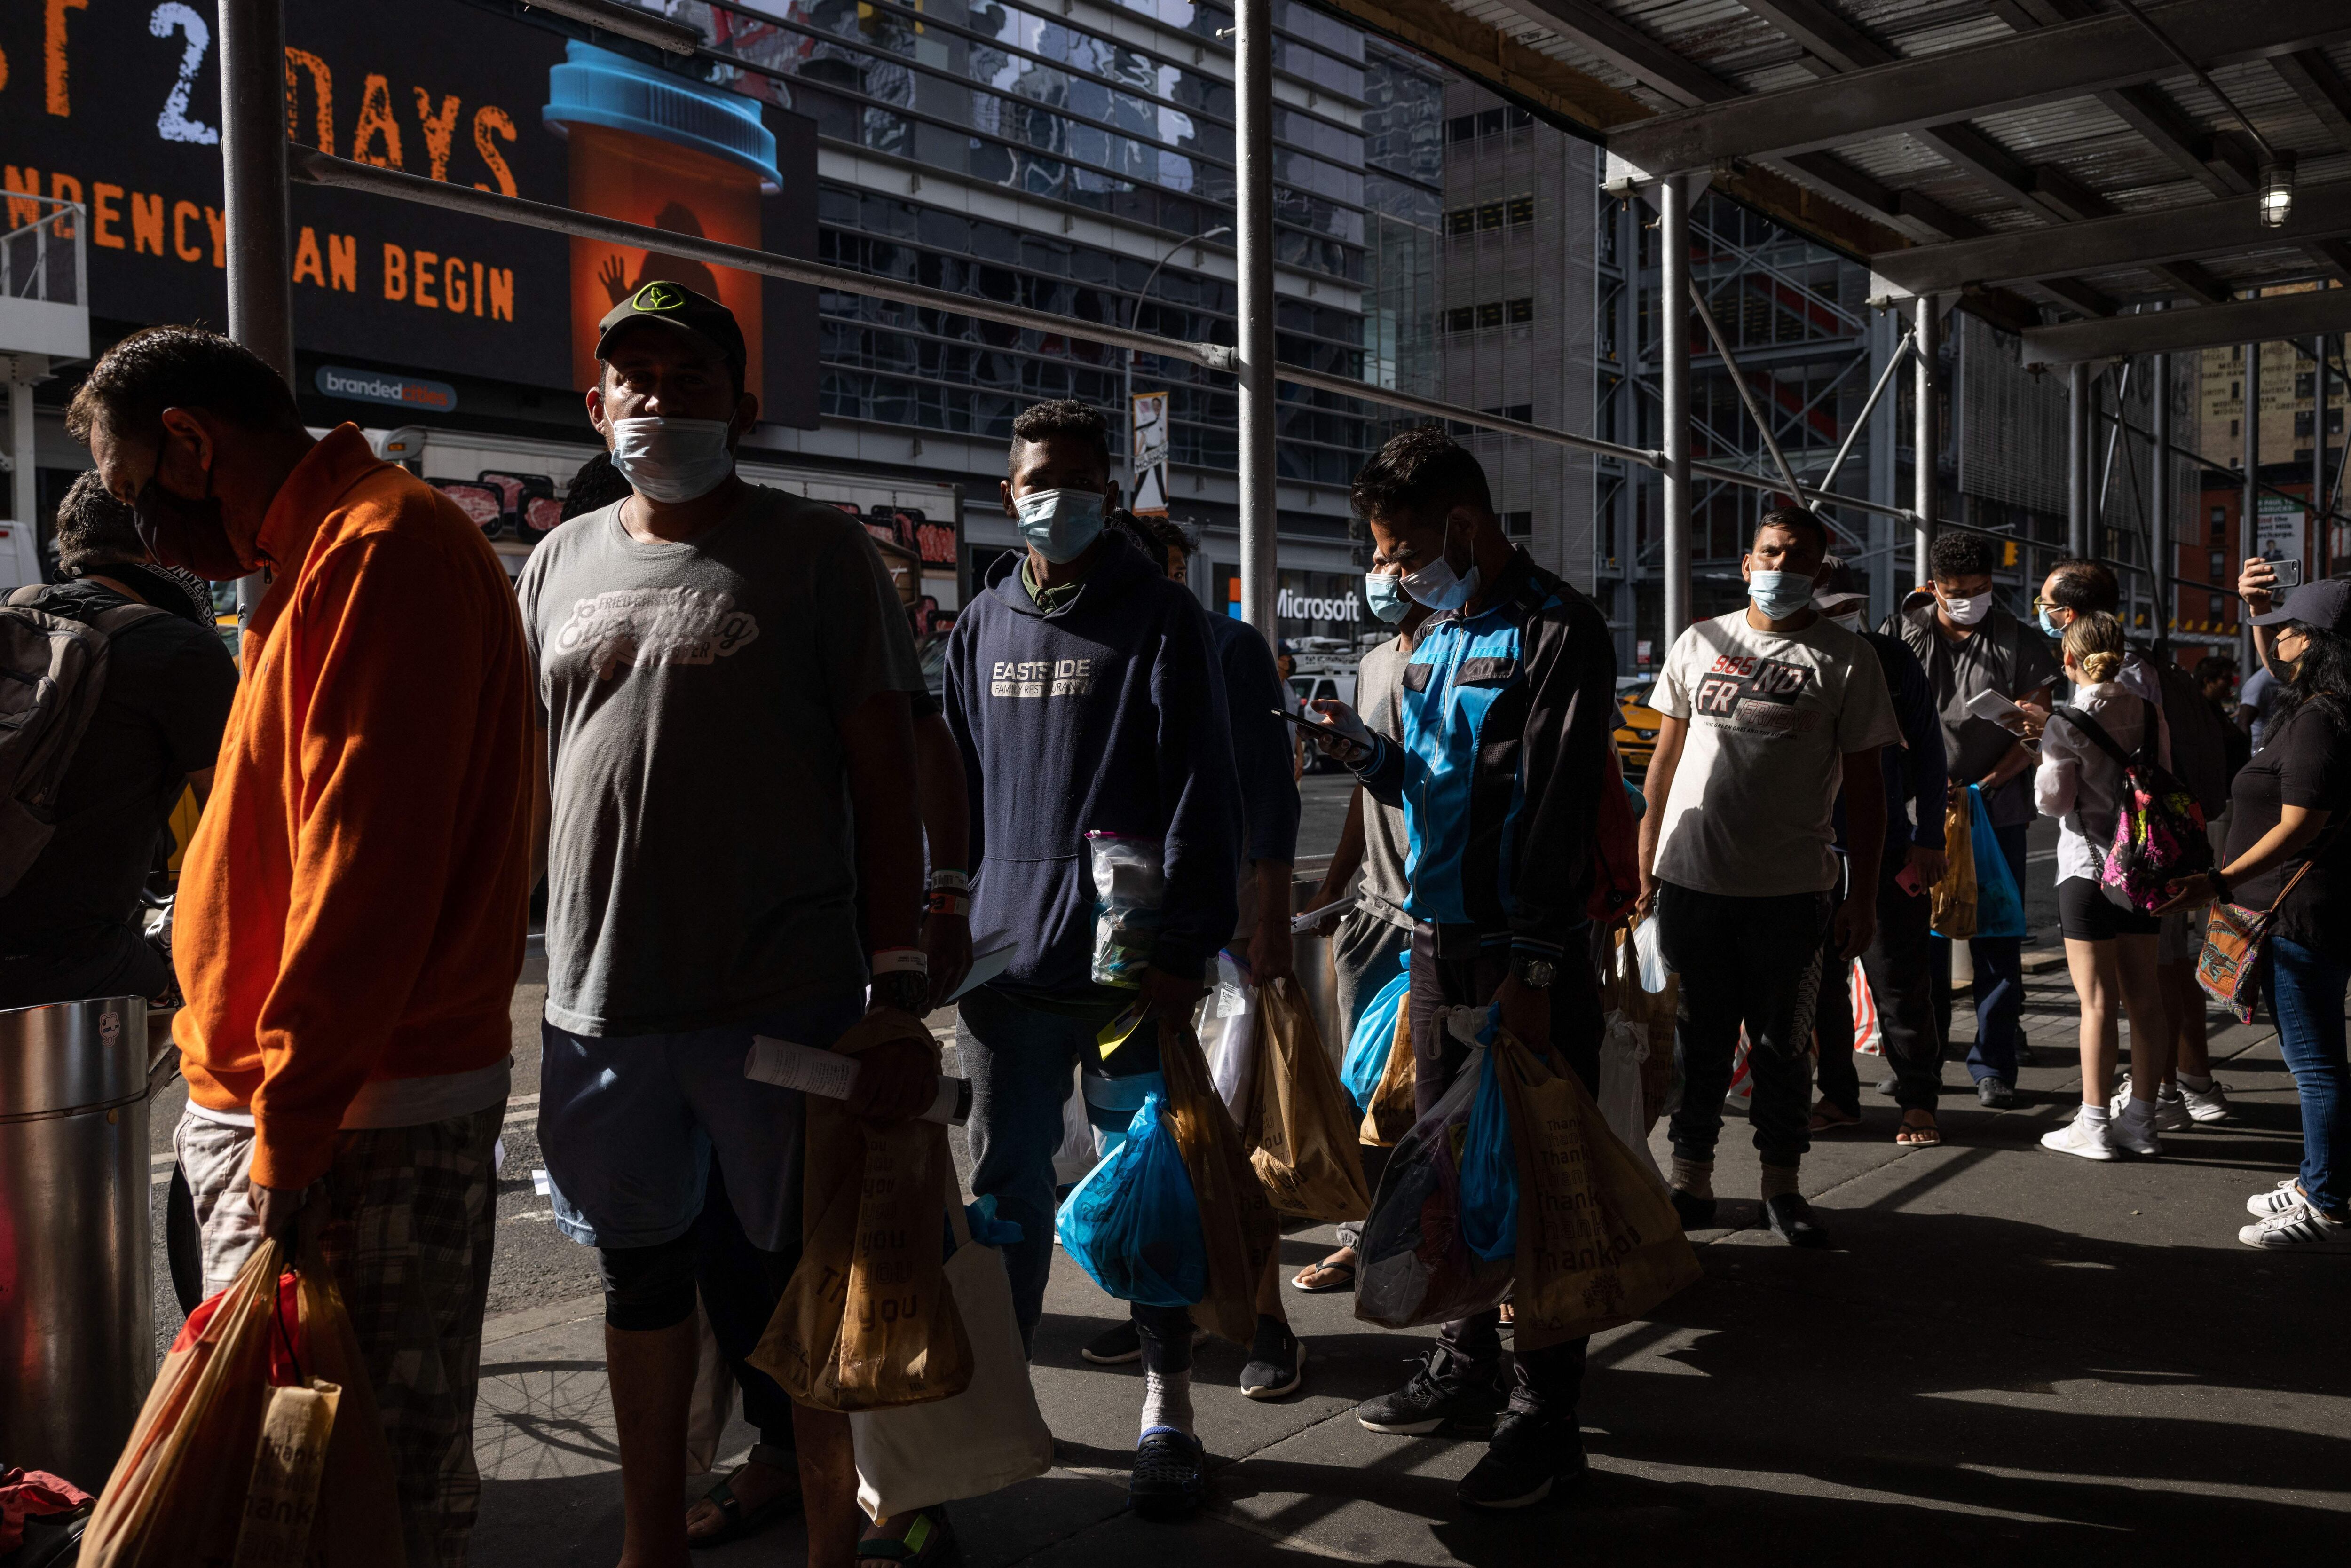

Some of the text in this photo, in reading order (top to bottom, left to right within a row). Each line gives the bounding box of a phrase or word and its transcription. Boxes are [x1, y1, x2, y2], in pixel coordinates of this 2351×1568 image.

[0, 0, 519, 221] T 2 DAYS
[292, 227, 357, 292] AN
[383, 243, 513, 322] BEGIN
[2202, 388, 2226, 396] UROPE
[1277, 588, 1360, 622] Microsoft
[992, 659, 1091, 680] EASTSIDE
[1711, 655, 1758, 676] 985
[995, 684, 1024, 693] FAMILY
[1697, 662, 1805, 713] FR ND
[1736, 701, 1821, 733] FRIEND
[1789, 966, 1816, 1045] RUNNING
[1547, 1116, 1583, 1131] Thank
[1539, 1143, 1591, 1166] Thank
[862, 1178, 894, 1198] you
[861, 1201, 898, 1227] you
[862, 1229, 906, 1258] you
[860, 1260, 913, 1294] you
[857, 1294, 918, 1333] you
